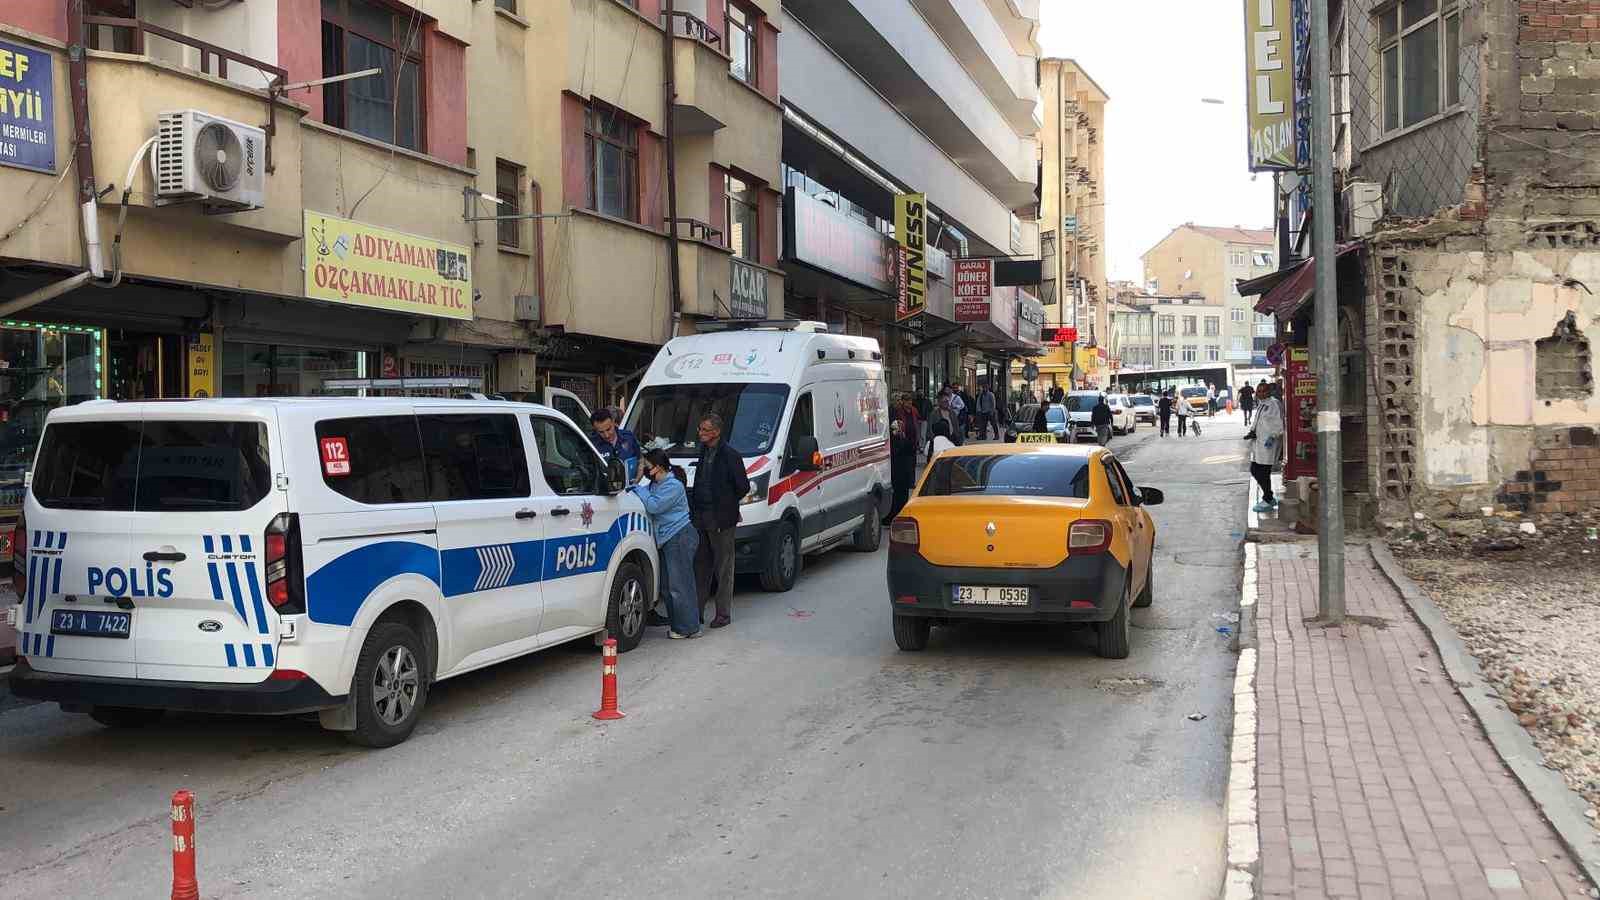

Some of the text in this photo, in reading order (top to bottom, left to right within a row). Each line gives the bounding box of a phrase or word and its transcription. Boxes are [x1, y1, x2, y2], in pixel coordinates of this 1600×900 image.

[2, 123, 47, 145] MERMİLERİ
[1253, 119, 1293, 167] ASLAN
[352, 233, 437, 271] ADIYAMAN
[314, 256, 437, 305] ÖZÇAKMAKLAR
[957, 270, 987, 282] DÖNER
[325, 441, 346, 460] 112
[555, 537, 597, 572] POLİS
[87, 561, 175, 598] POLİS
[959, 587, 1027, 602] 23 T 0536
[60, 613, 128, 632] 23 A 7422
